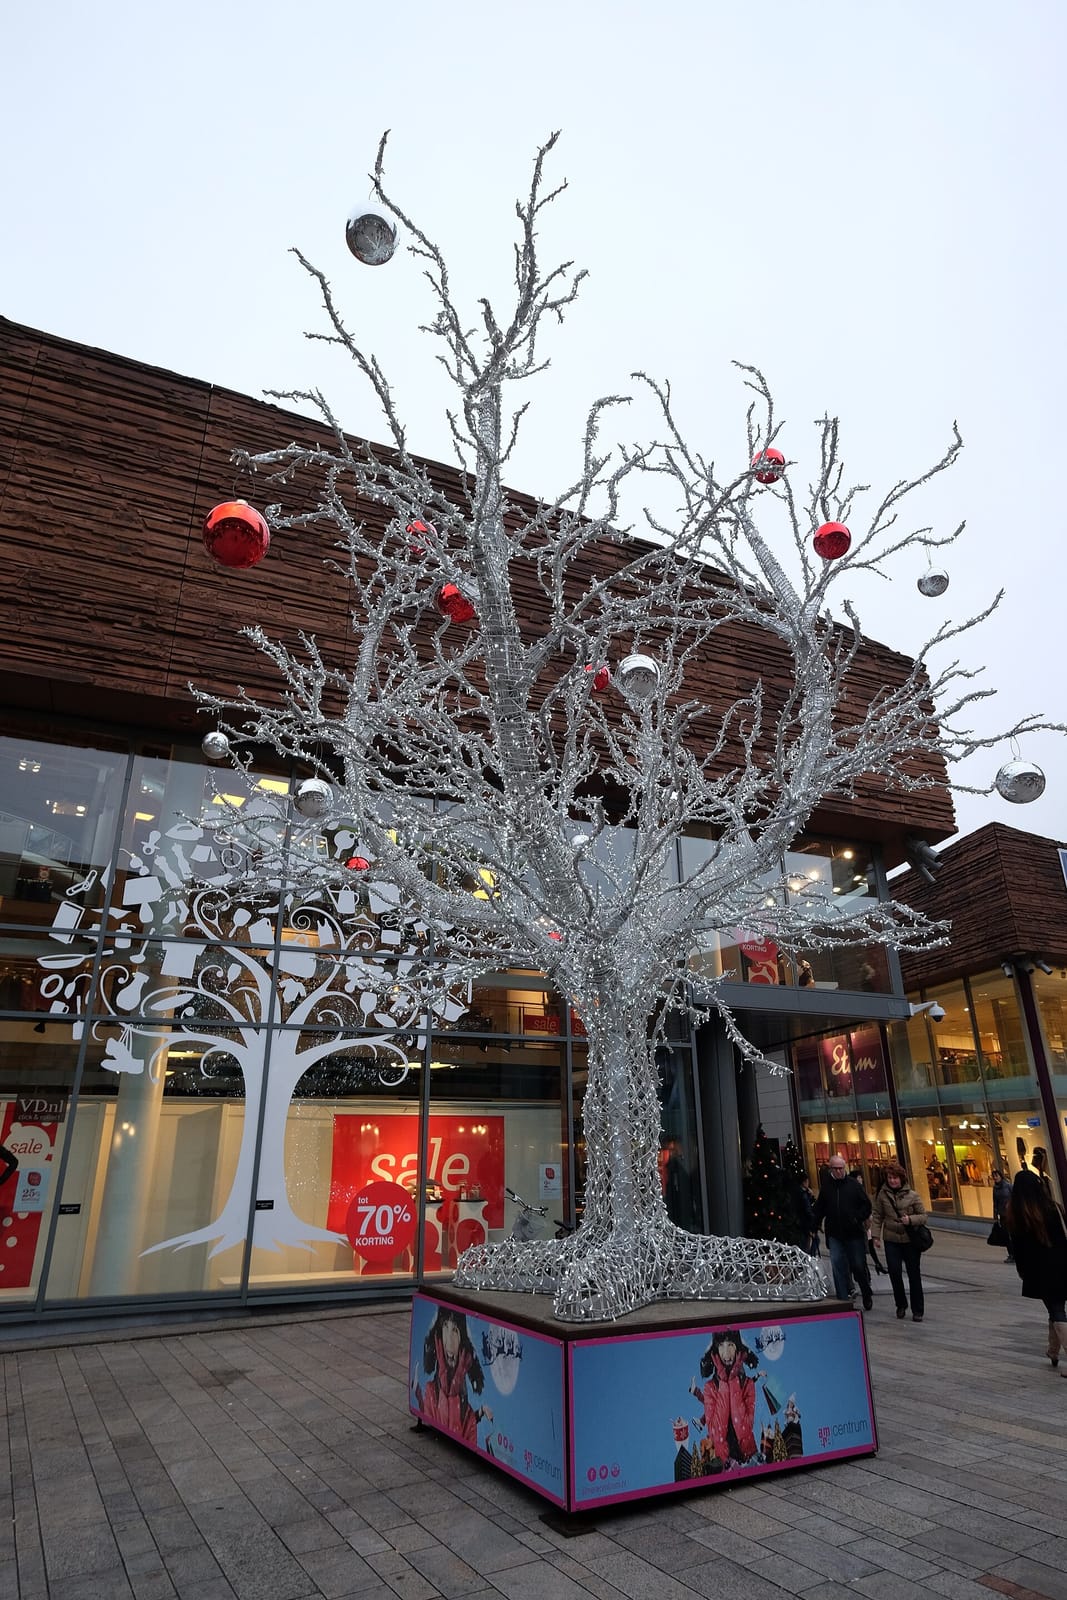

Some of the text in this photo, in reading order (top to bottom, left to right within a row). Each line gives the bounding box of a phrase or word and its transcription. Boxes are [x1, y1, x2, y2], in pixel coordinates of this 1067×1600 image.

[534, 1017, 557, 1031] sale
[19, 1098, 65, 1113] VD.nl
[10, 1138, 43, 1154] sale
[357, 1204, 411, 1236] 70%
[355, 1236, 394, 1247] KORTING
[832, 1419, 869, 1437] centrum
